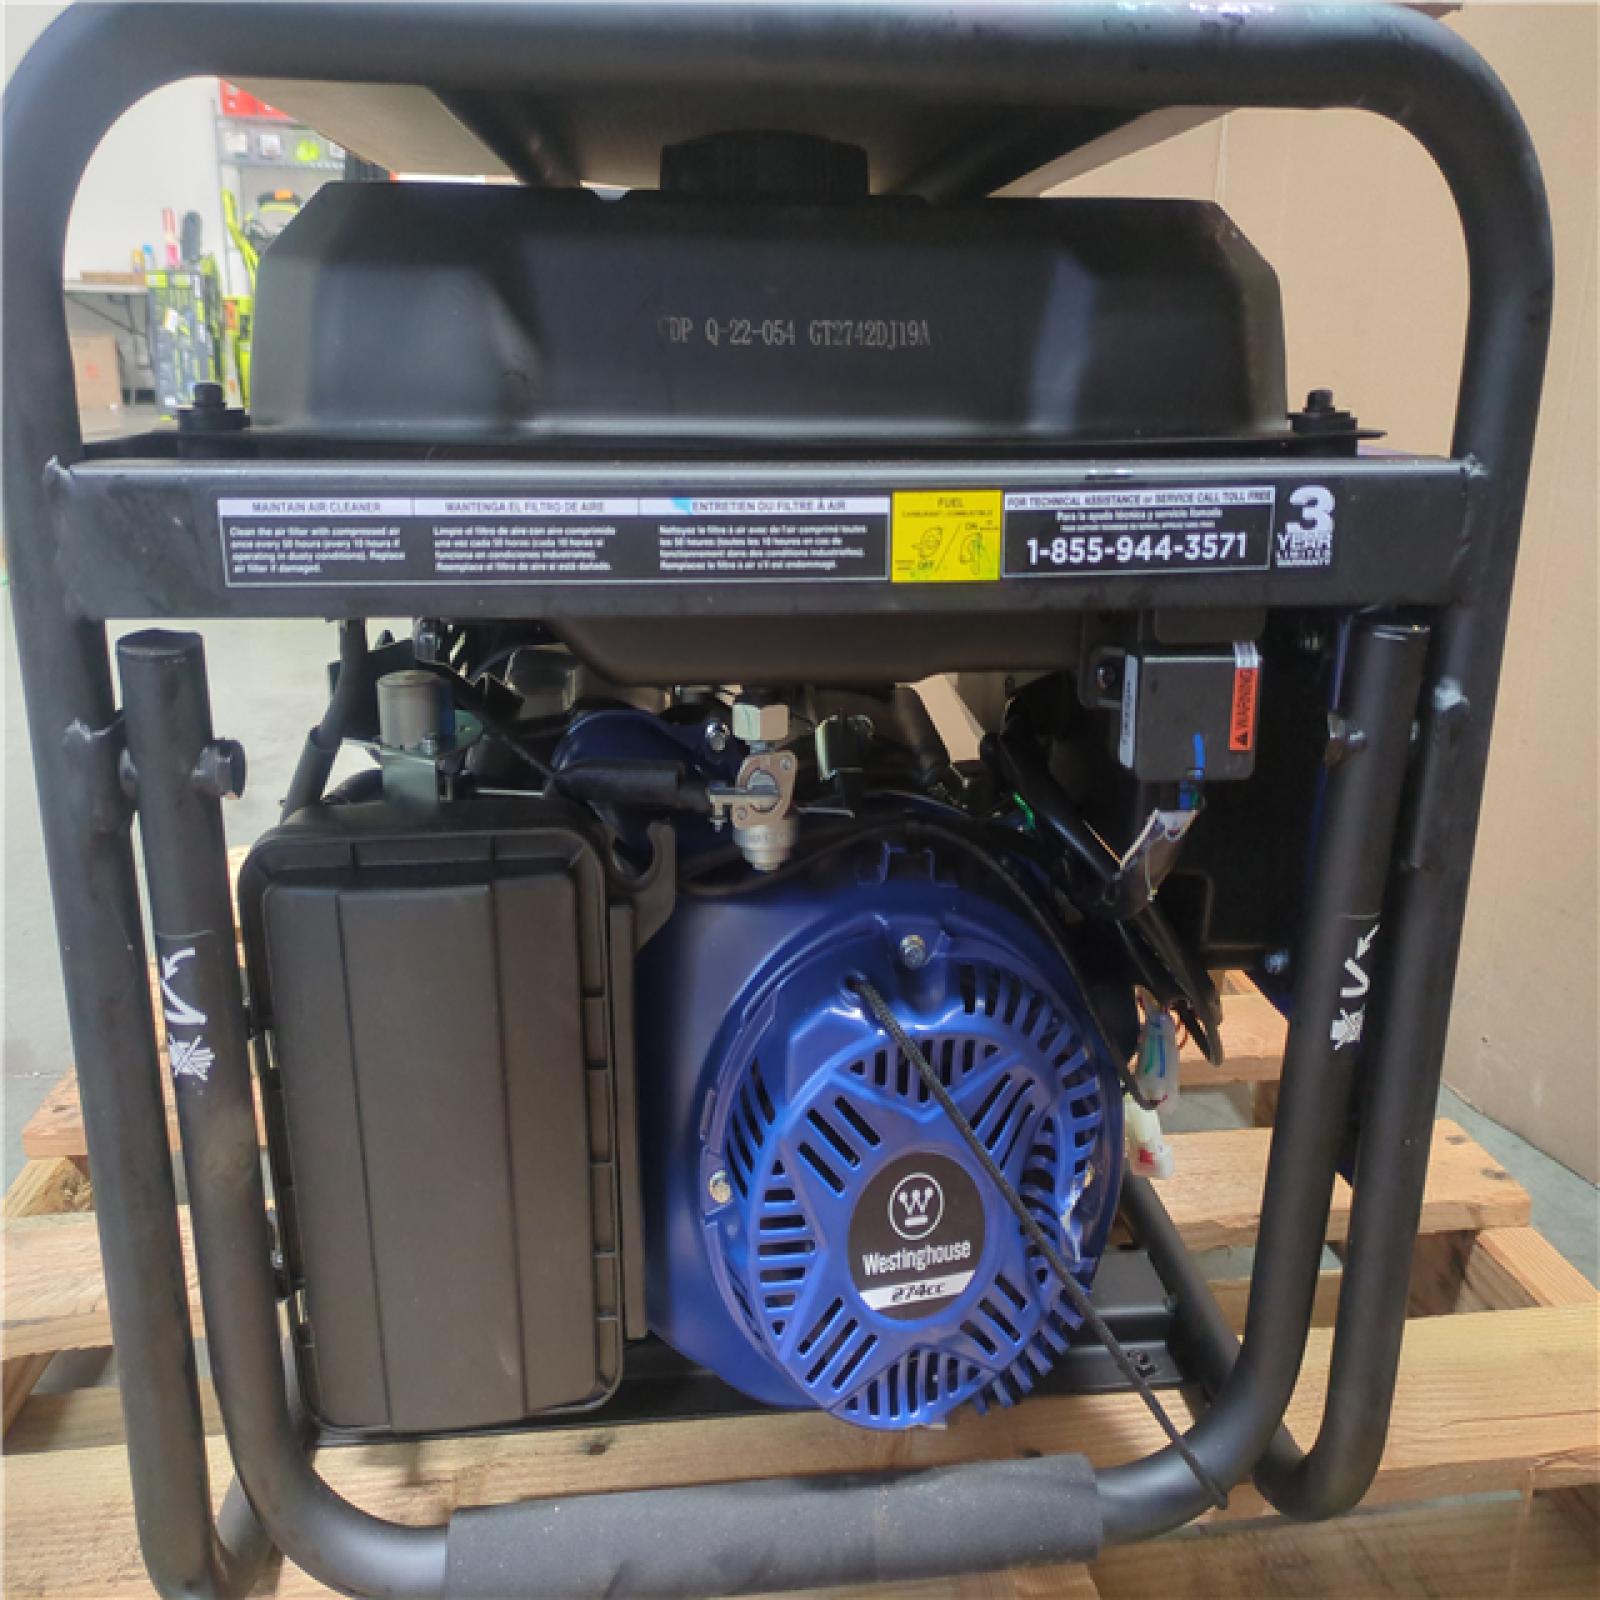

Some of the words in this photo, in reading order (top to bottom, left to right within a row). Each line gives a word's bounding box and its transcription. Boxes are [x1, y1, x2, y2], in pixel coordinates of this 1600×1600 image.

[704, 317, 797, 346] Q-22-054
[252, 501, 305, 513] MAINTAIN
[308, 501, 326, 513] AIR
[329, 501, 382, 513] CLEANER
[445, 501, 506, 512] MANTENGA
[509, 501, 520, 512] EL
[524, 501, 561, 512] FILTRO
[564, 501, 576, 512] DE
[579, 501, 604, 512] AIRE
[692, 501, 755, 511] ENTRETIEN
[758, 501, 773, 511] DU
[777, 501, 812, 511] FILTRE
[816, 498, 826, 511] À
[829, 501, 846, 511] AIR
[937, 496, 963, 509] FUEL
[1007, 496, 1026, 507] FOR
[1029, 495, 1081, 506] TECHNICAL
[1084, 493, 1141, 505] ASSISTANCE
[1155, 493, 1193, 504] SERVICE
[1197, 492, 1219, 502] CALL
[1222, 491, 1245, 501] TOLL
[1247, 490, 1271, 500] FREE
[1285, 485, 1335, 534] 3
[1026, 532, 1248, 567] 1-855-944-3571
[1276, 532, 1332, 550] YEAR
[1235, 669, 1254, 730] WARNING
[862, 1240, 971, 1276] Westinghouse
[891, 1282, 945, 1303] 274cc
